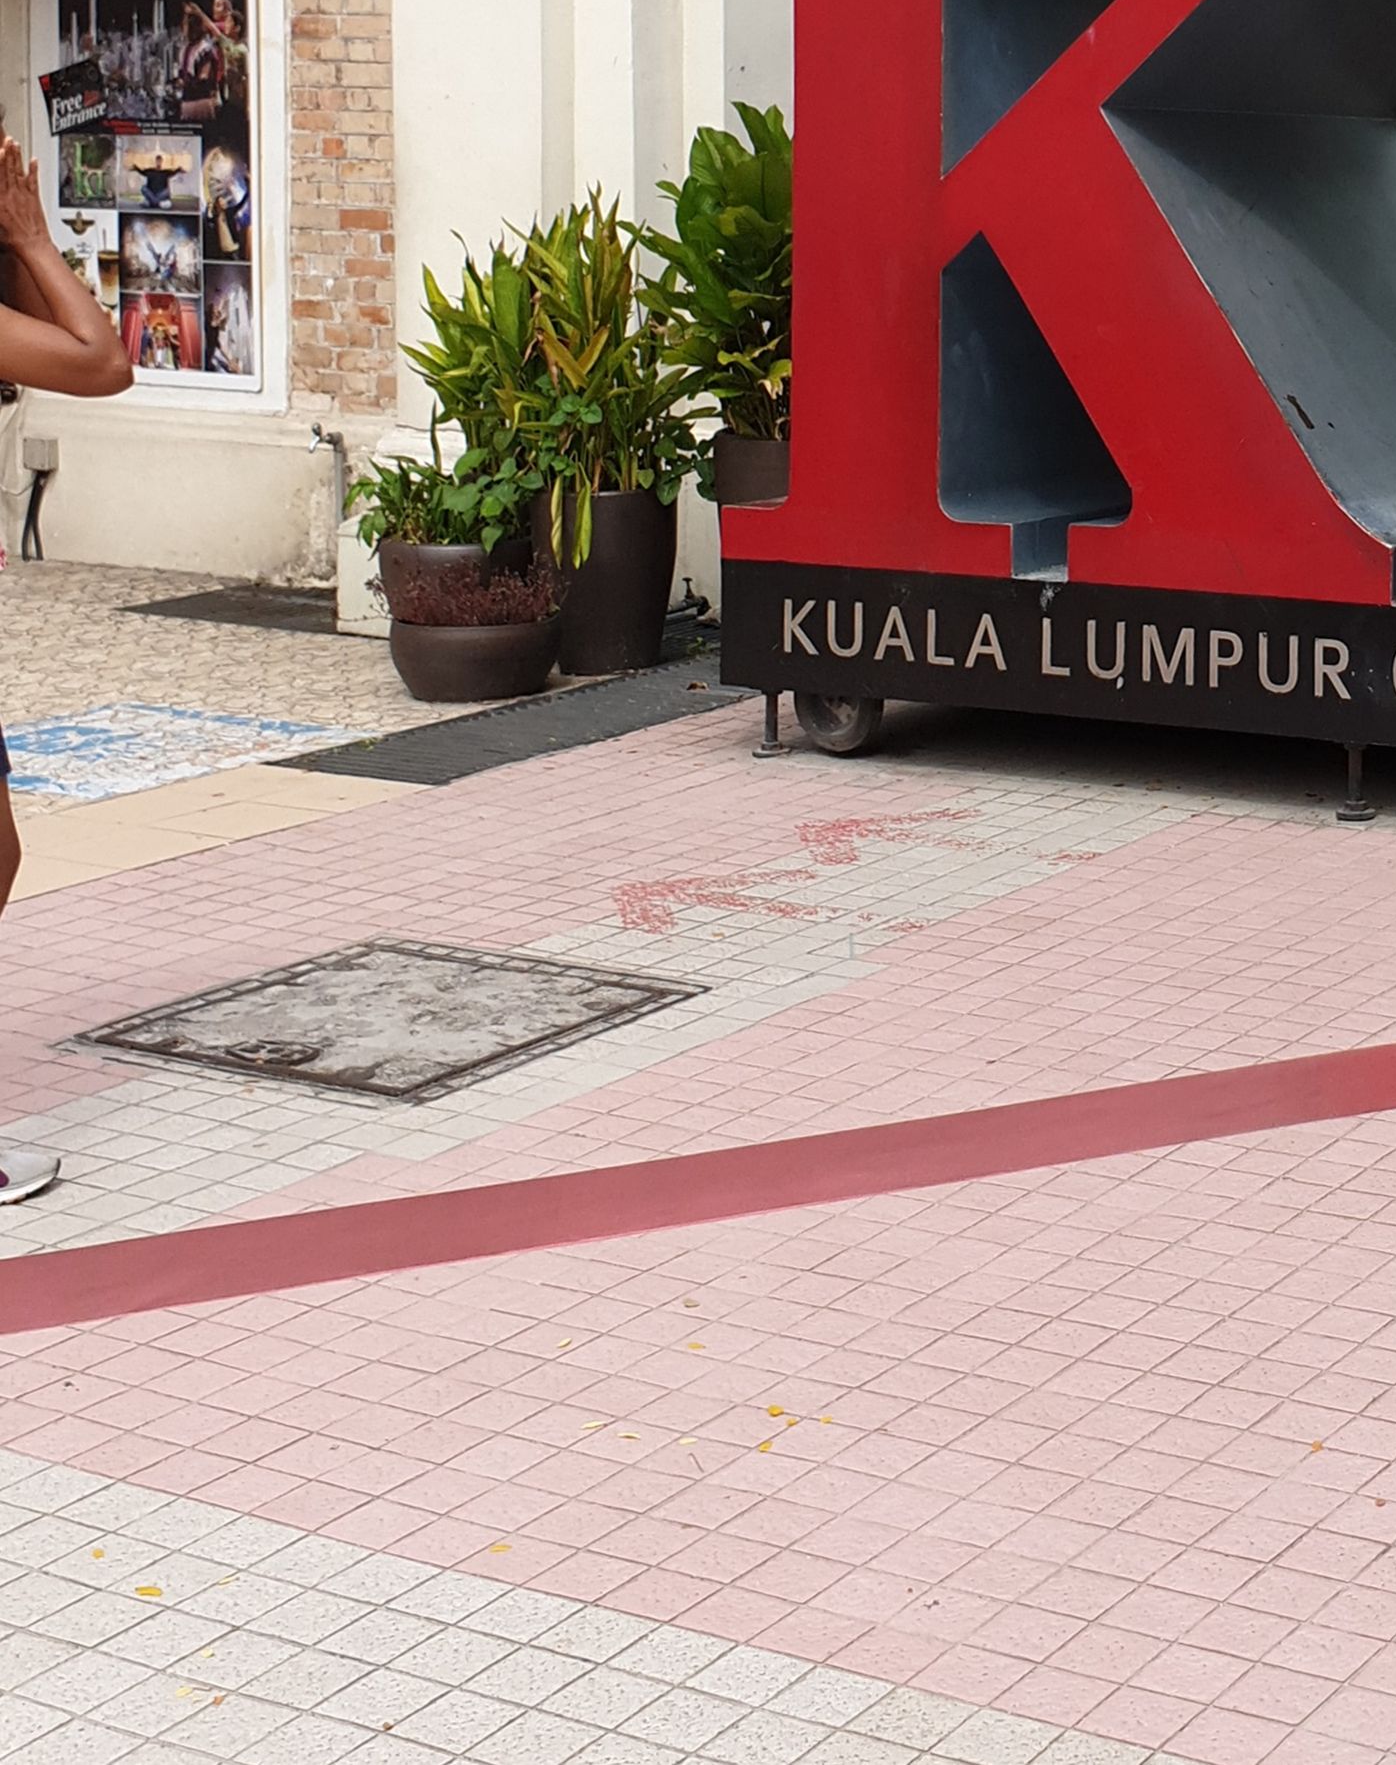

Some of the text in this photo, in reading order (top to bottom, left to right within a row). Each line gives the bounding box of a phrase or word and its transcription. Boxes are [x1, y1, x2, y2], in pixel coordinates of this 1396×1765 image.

[52, 93, 83, 116] Free
[52, 102, 107, 133] Entrance
[783, 599, 1007, 671] KUALA
[1041, 617, 1352, 700] LUMPUR
